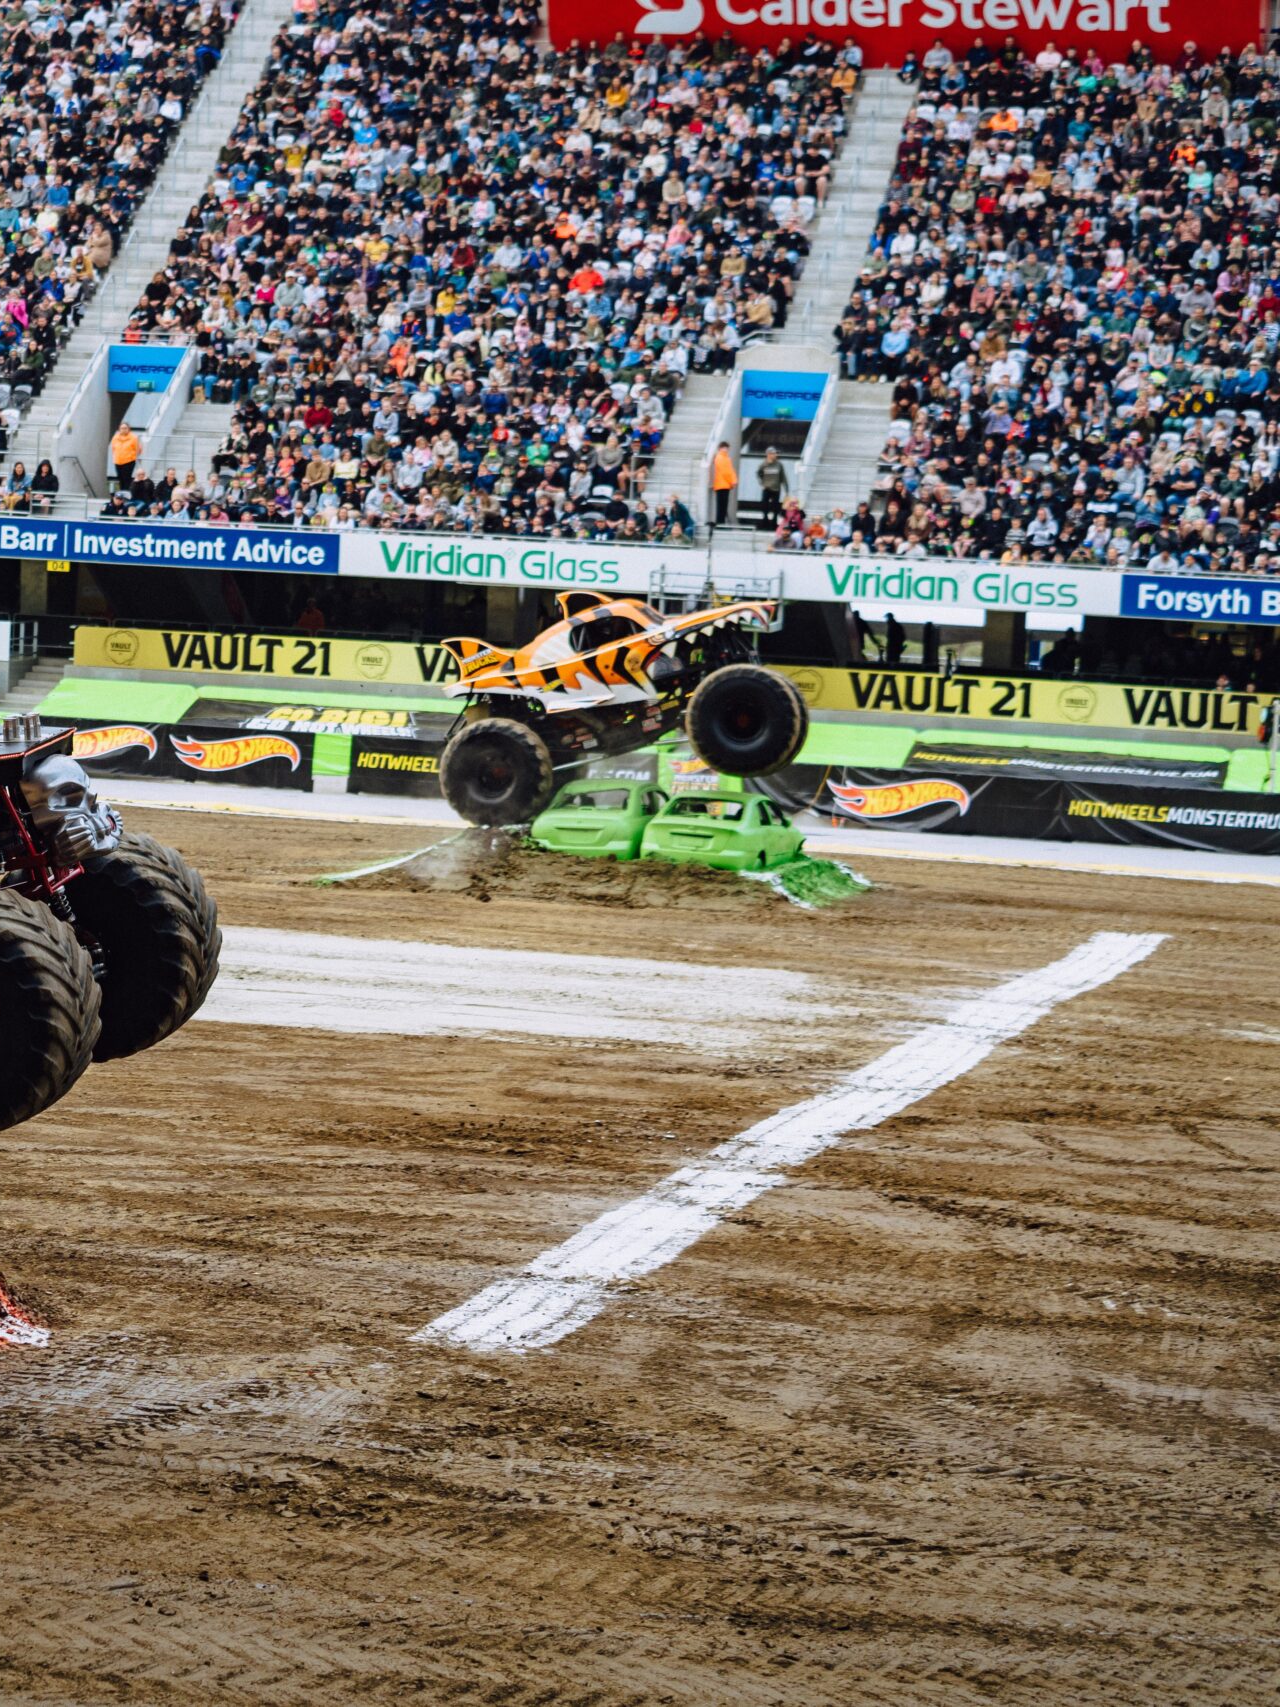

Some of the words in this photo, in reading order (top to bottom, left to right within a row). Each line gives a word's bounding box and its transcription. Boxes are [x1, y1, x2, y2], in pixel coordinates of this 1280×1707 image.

[716, 0, 904, 28] Calder
[919, 0, 1172, 33] Stewart
[0, 524, 57, 551] Barr
[74, 528, 226, 561] Investment
[232, 537, 325, 566] Advice
[52, 561, 65, 571] 04
[380, 541, 506, 578] Viridian
[520, 550, 620, 584] Glass
[827, 564, 958, 602] Viridian
[973, 573, 1078, 607] Glass
[1137, 583, 1251, 618] Forsyth
[161, 633, 284, 674] VAULT
[292, 640, 332, 677] 21
[849, 672, 980, 714] VAULT
[989, 681, 1033, 718] 21
[1123, 688, 1259, 732] VAULT
[357, 752, 441, 773] HOTWHEEL
[1068, 799, 1280, 829] HOTWHEELSMONSTERTRU
